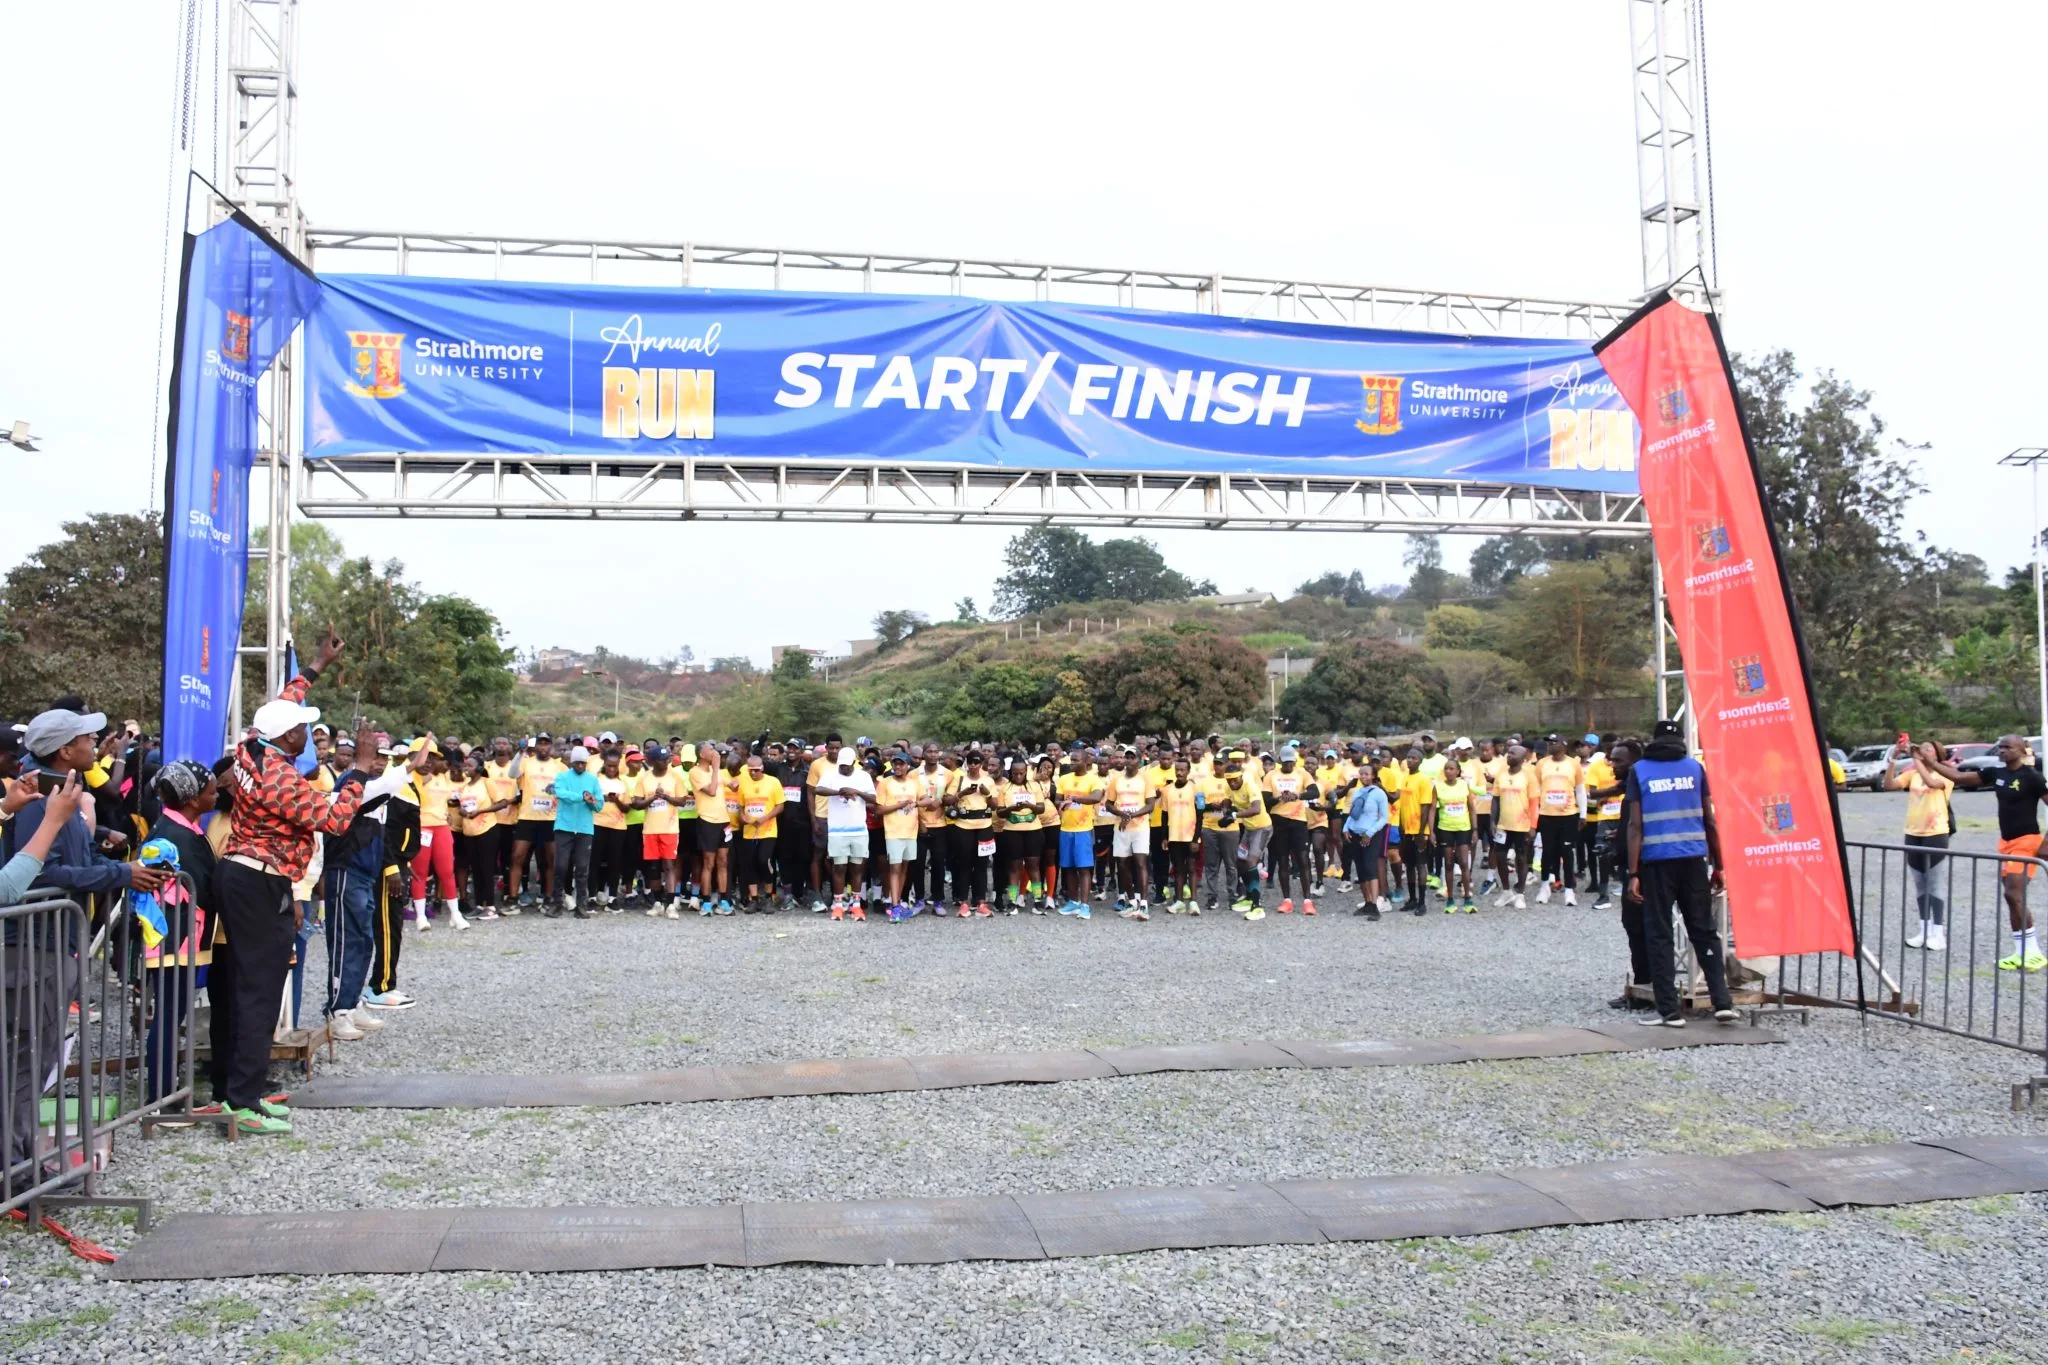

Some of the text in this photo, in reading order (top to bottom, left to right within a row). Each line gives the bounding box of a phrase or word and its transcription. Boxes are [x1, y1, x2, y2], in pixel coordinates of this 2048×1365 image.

[415, 337, 544, 361] Strathmore
[600, 313, 722, 364] Annual
[415, 363, 543, 380] UNIVERSITY
[774, 351, 1312, 428] START/ FINISH
[602, 366, 715, 440] RUN
[1411, 381, 1509, 404] Strathmore
[1410, 404, 1506, 420] UNIVERSITY
[1548, 408, 1635, 472] RUN
